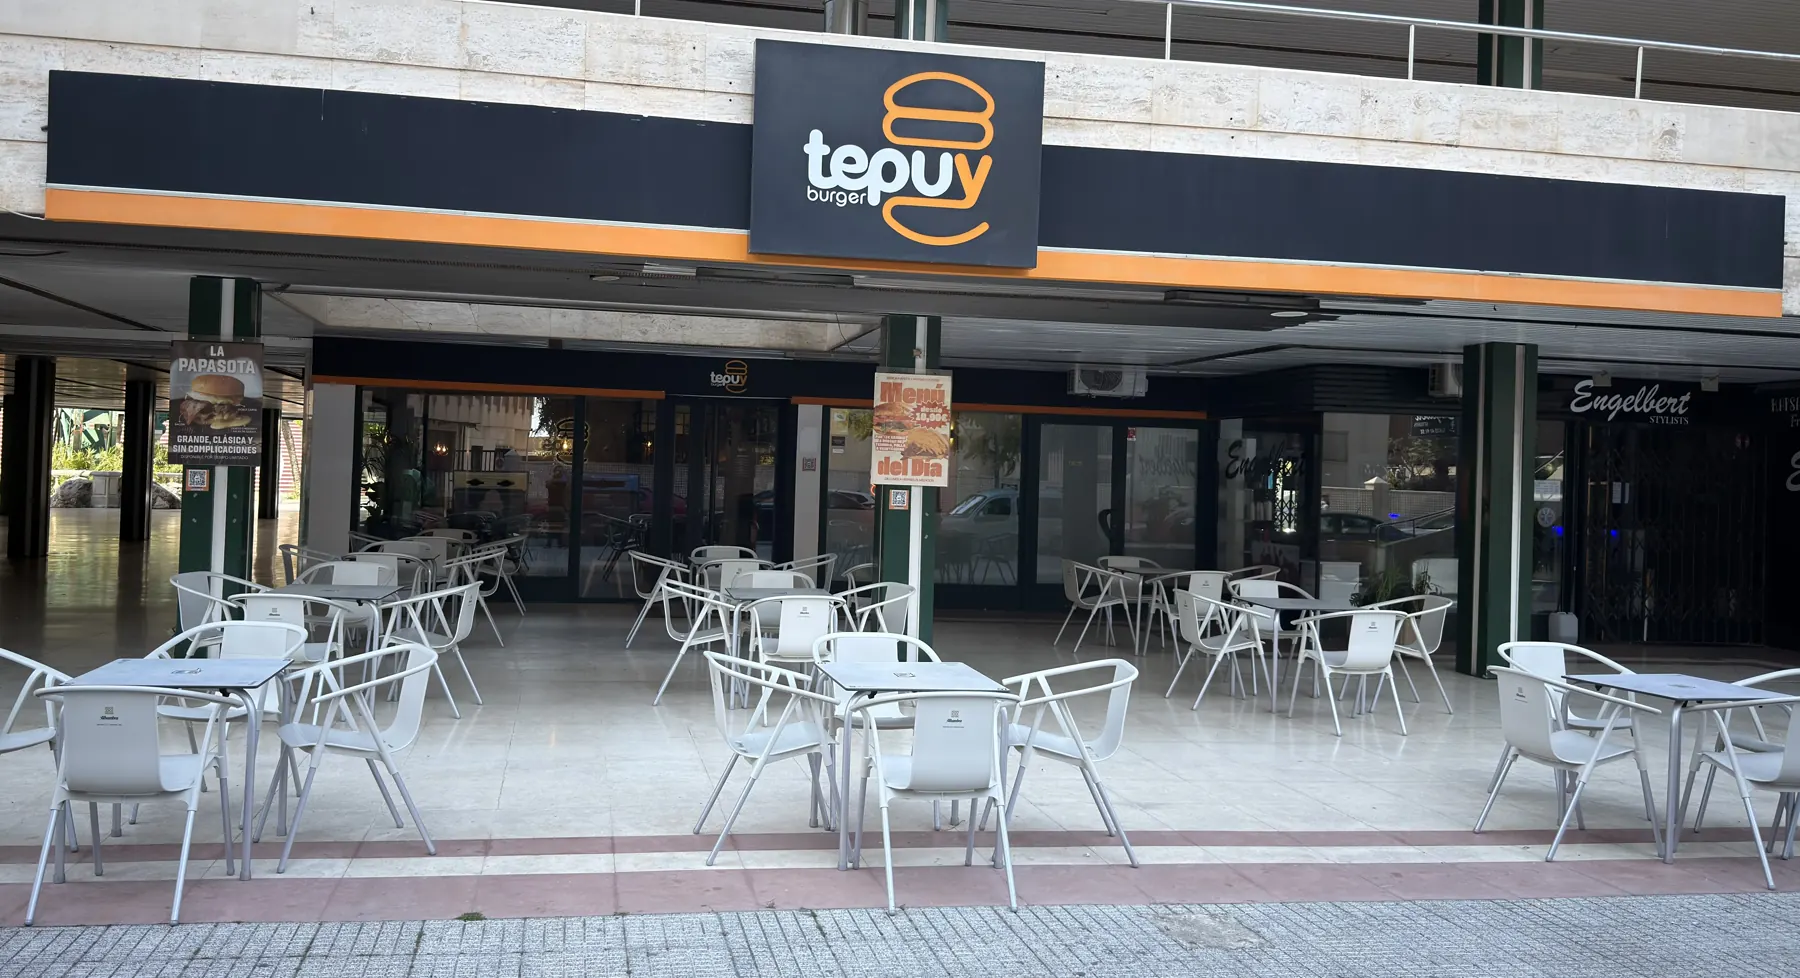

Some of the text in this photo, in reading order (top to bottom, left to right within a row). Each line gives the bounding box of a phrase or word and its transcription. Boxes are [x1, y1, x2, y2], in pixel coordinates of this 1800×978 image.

[803, 129, 993, 209] tepuy
[807, 186, 867, 207] burger
[210, 345, 225, 357] LA
[178, 357, 256, 374] PAPASOTA
[710, 371, 747, 386] tepuy
[881, 381, 946, 403] Menú
[1570, 379, 1691, 421] Engelbert
[1649, 415, 1689, 425] STYLISTS
[177, 433, 253, 445] GRANDE, CLÁSICA Y
[172, 444, 257, 454] SIN COMPLICACIONES
[877, 456, 908, 476] del
